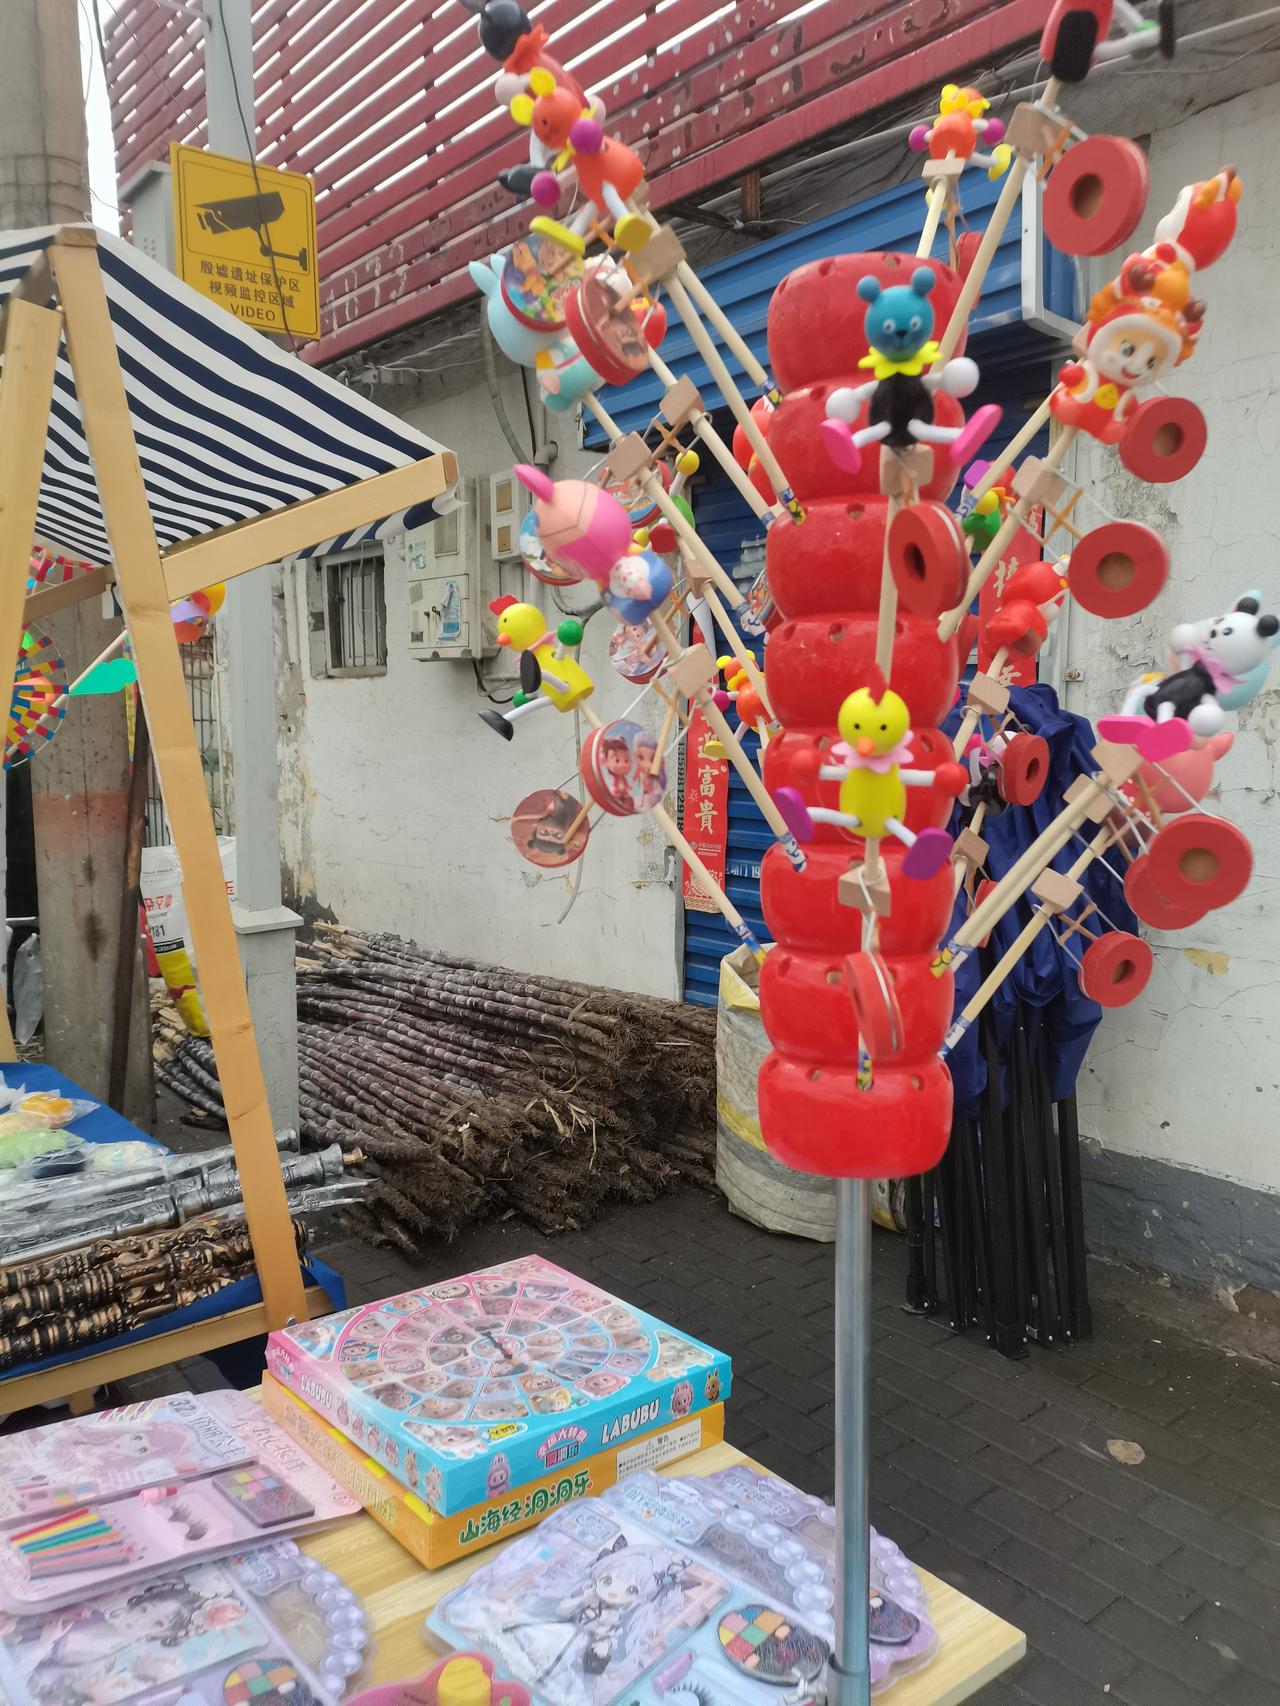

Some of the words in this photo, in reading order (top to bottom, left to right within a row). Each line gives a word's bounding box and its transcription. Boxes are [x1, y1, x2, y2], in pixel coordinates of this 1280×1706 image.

[201, 260, 300, 292] 殷墟遗址保护区
[209, 280, 295, 309] 视频监控区域
[230, 303, 276, 321] VIDEO
[600, 1396, 661, 1446] LABUBU
[458, 1469, 592, 1544] 山海经洞洞乐
